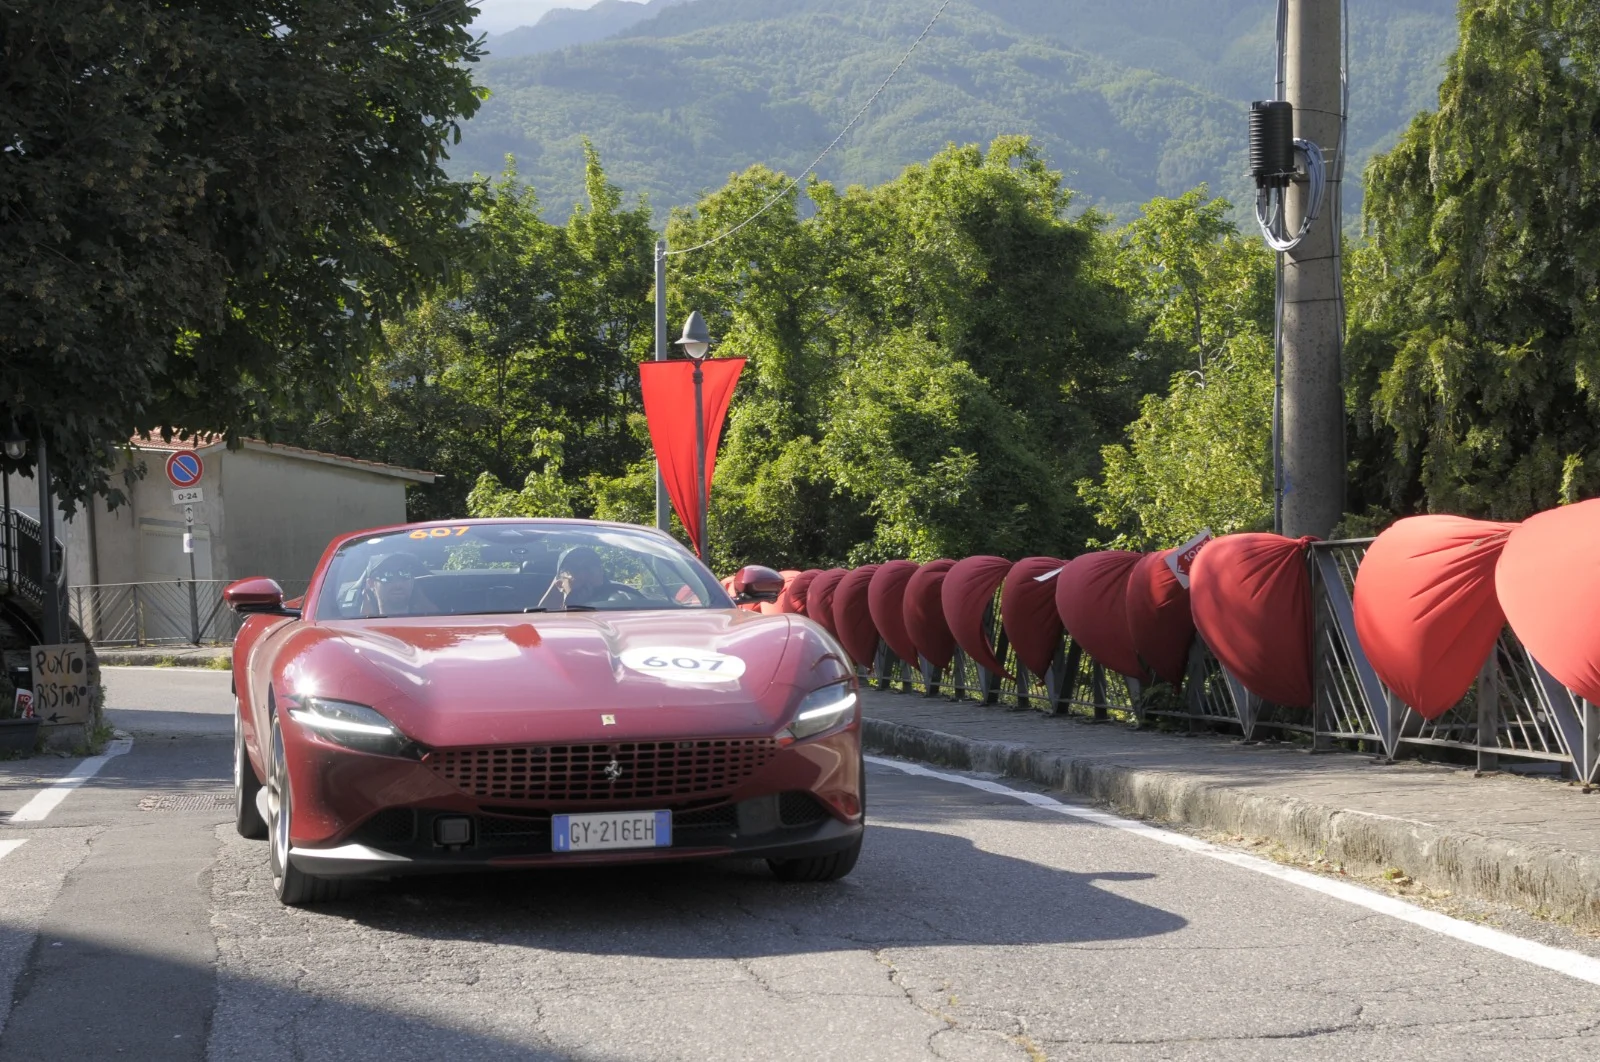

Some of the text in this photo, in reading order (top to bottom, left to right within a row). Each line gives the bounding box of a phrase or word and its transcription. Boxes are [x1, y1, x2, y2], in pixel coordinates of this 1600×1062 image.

[178, 492, 198, 501] 0-24
[409, 526, 470, 540] 607
[36, 649, 84, 675] PUNTO
[642, 656, 724, 671] 607
